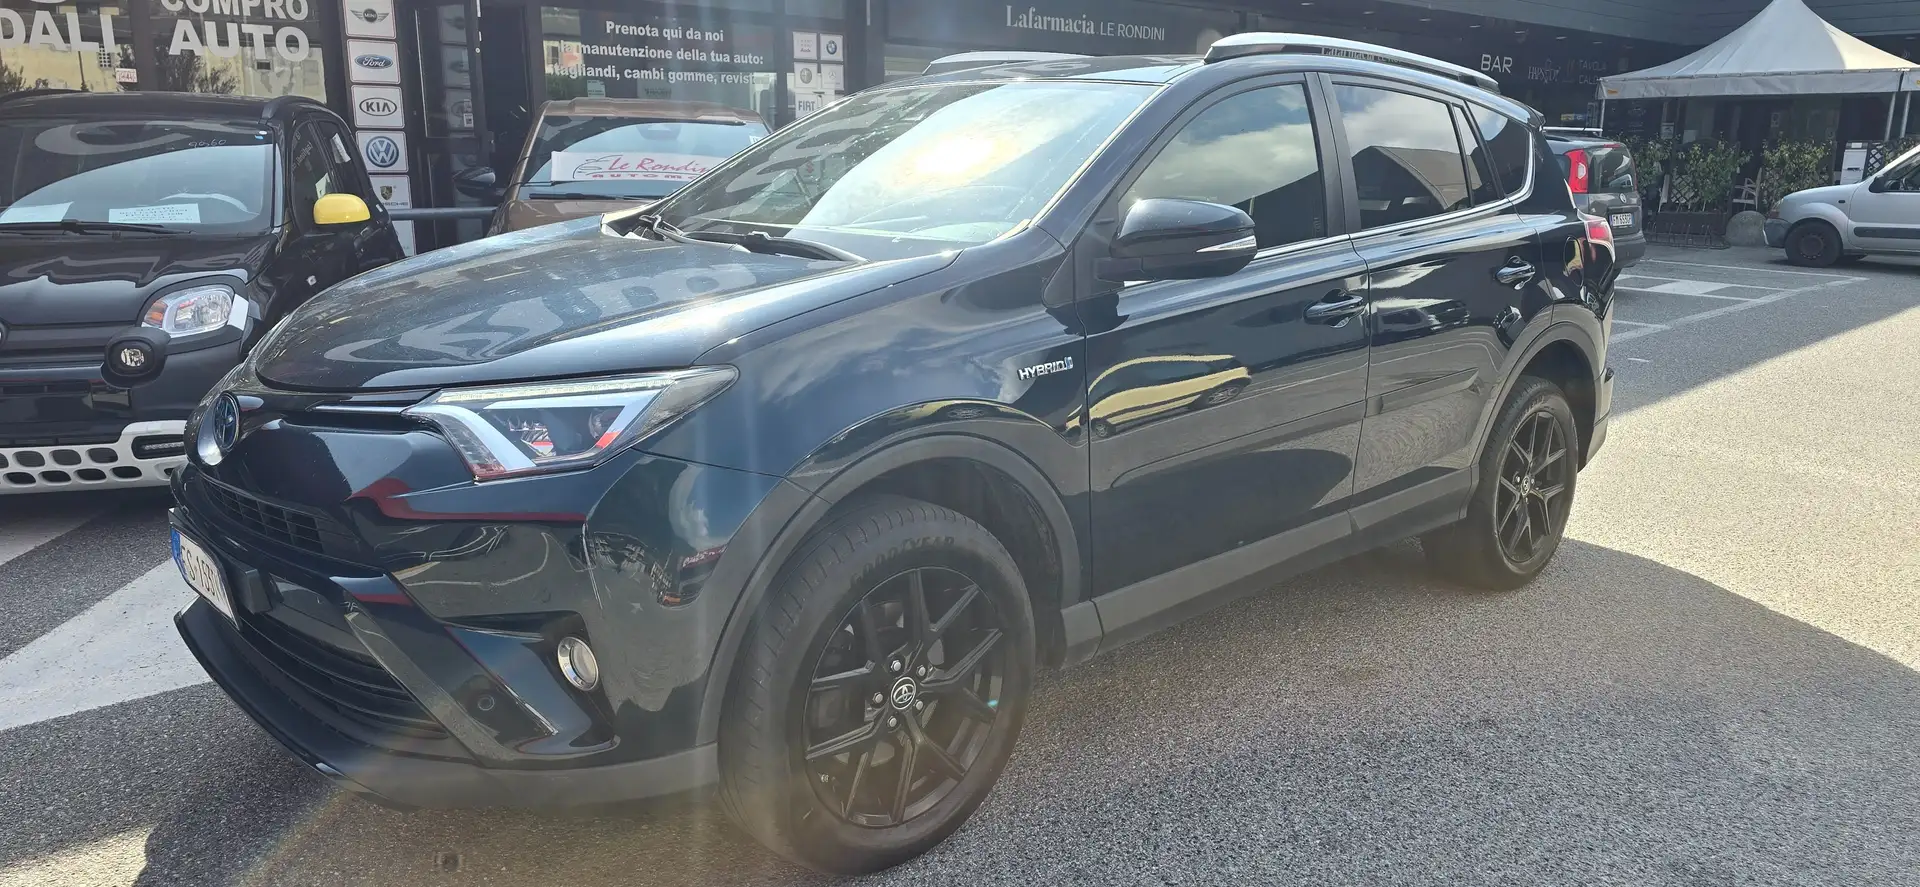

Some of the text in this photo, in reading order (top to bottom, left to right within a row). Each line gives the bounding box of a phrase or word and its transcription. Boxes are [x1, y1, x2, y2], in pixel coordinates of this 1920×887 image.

[169, 19, 310, 62] AUTO
[606, 20, 724, 42] Prenota qui da noi
[1100, 21, 1115, 36] LE
[1118, 23, 1165, 41] RONDINI
[361, 56, 388, 68] Ford
[560, 39, 764, 65] la manutenzione della tua auto:
[1480, 53, 1513, 74] BAR
[624, 67, 664, 80] cambi
[668, 71, 717, 85] gomme,
[364, 100, 393, 113] KIA
[798, 100, 816, 111] FIAT
[608, 157, 707, 173] Le Rondin
[1018, 359, 1068, 381] HYBRID
